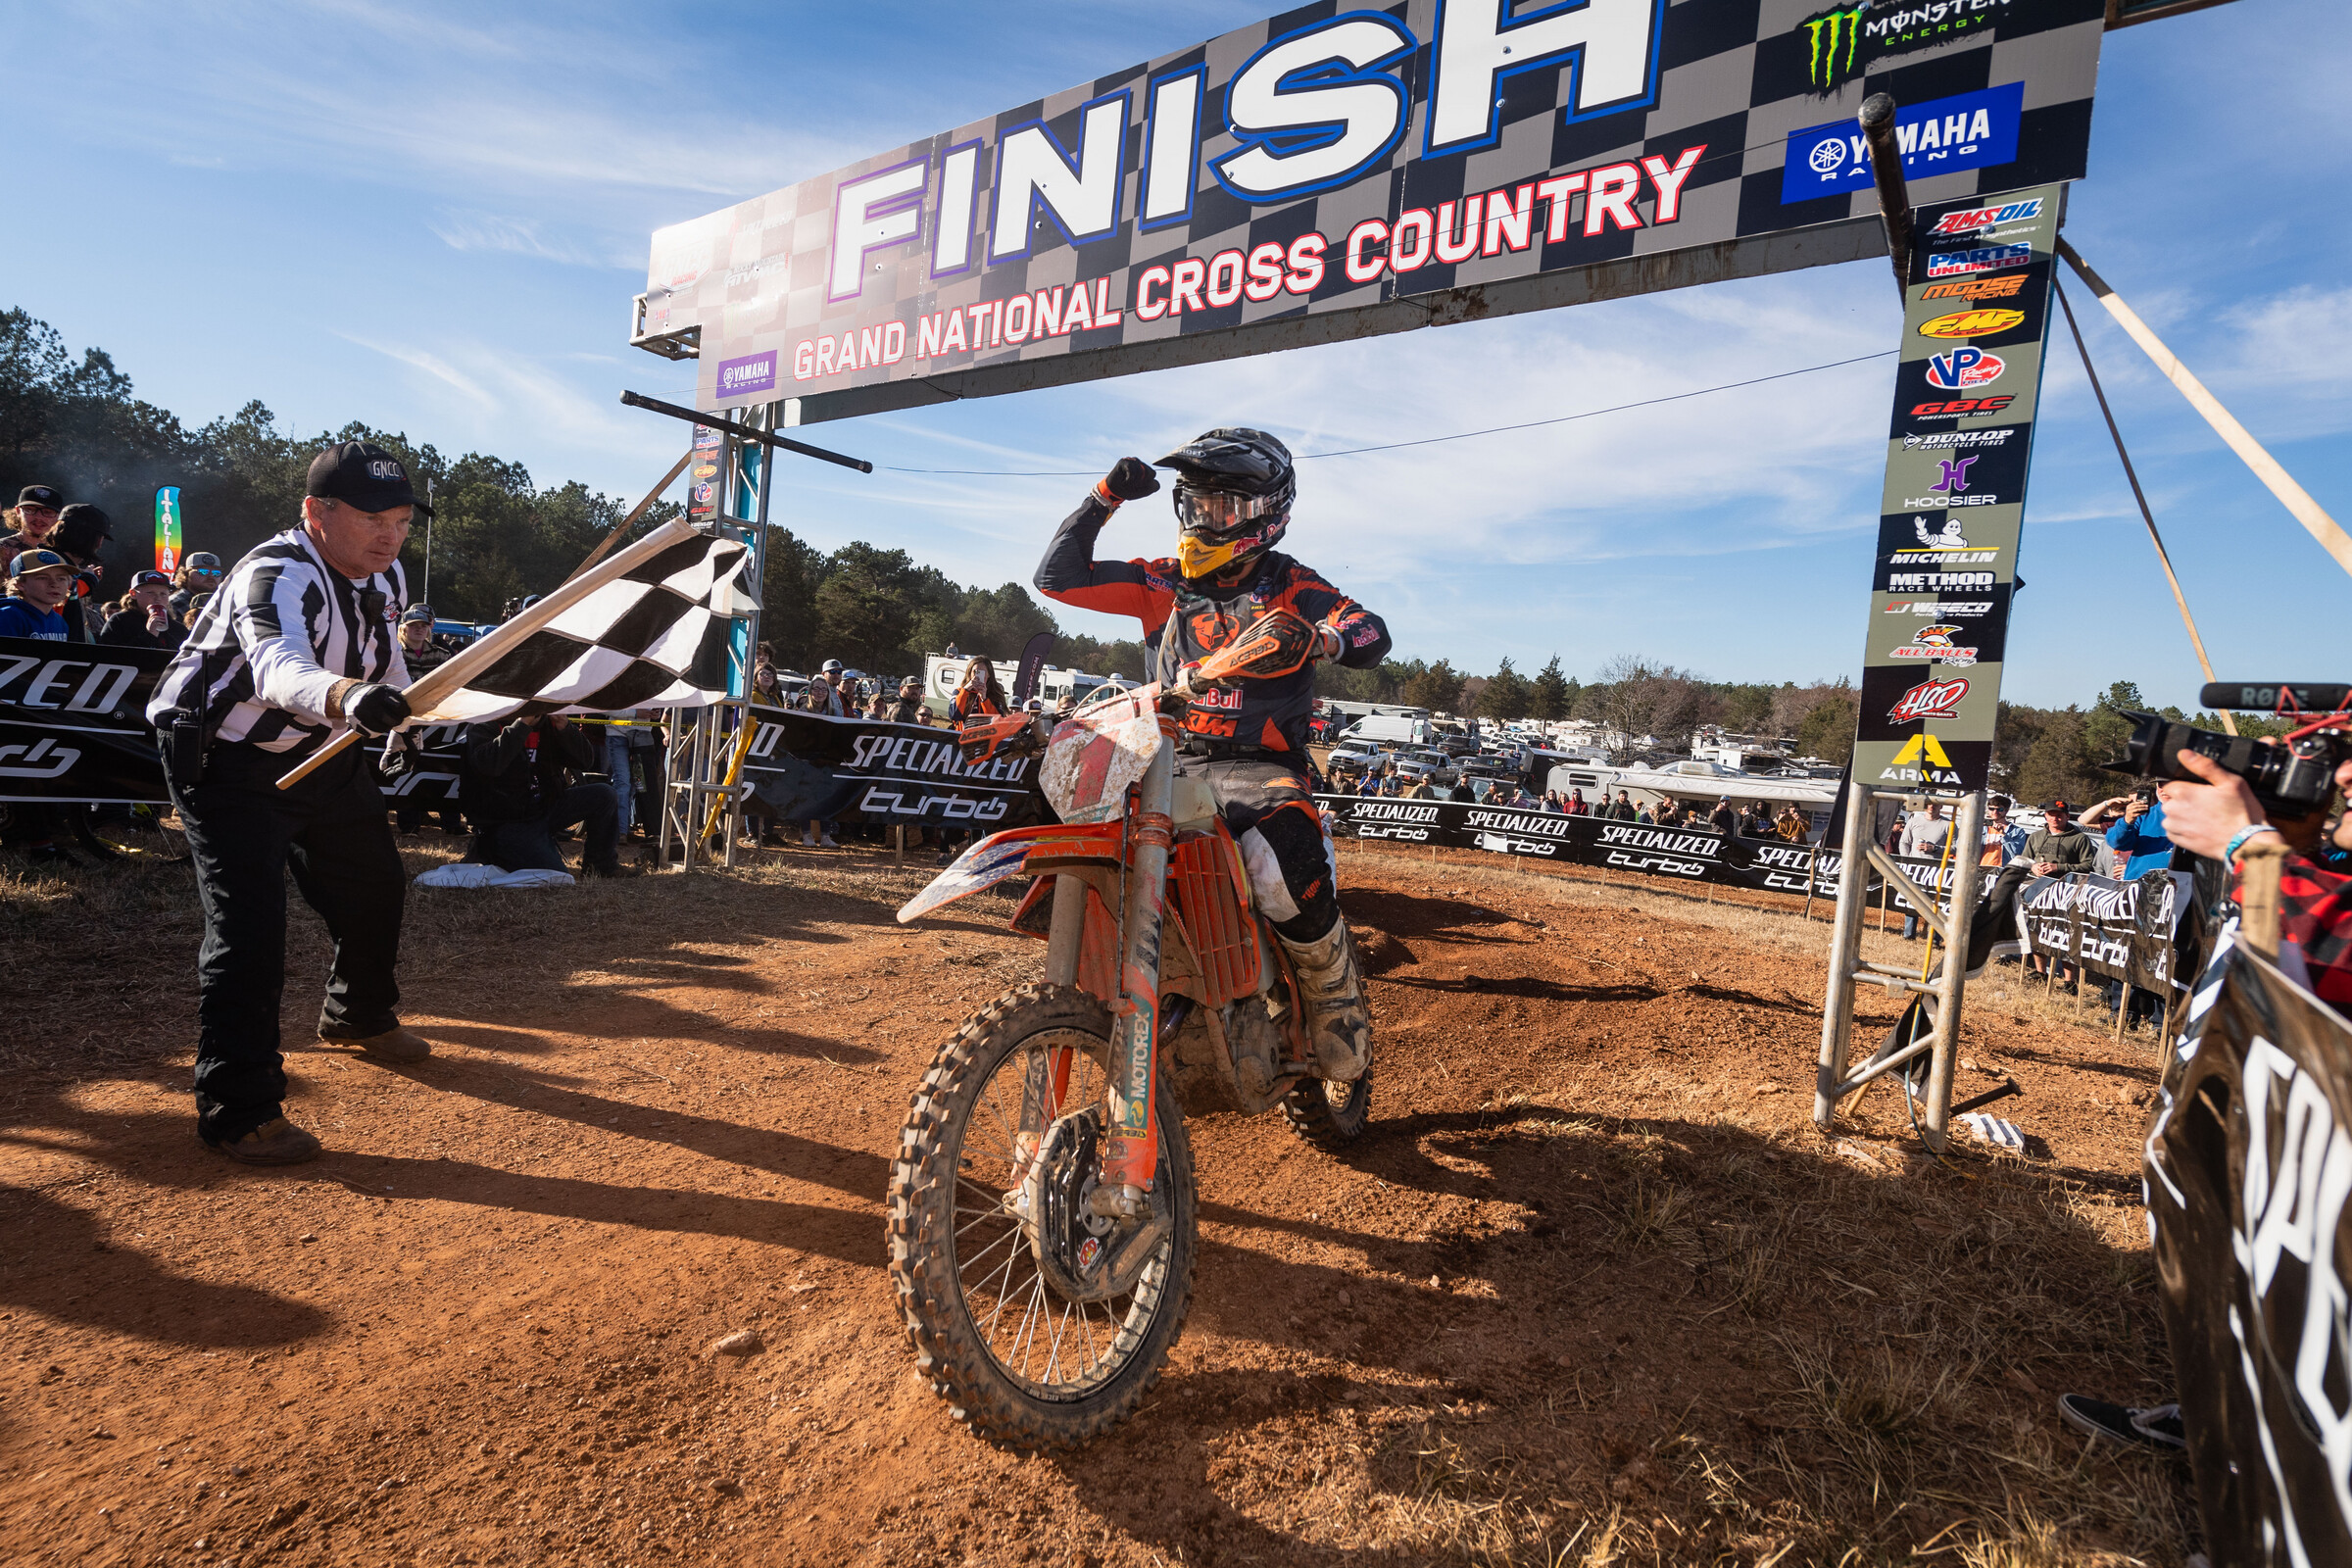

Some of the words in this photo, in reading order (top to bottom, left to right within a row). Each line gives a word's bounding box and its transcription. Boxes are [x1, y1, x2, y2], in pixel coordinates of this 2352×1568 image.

[1886, 15, 1985, 46] ENERGY
[1850, 109, 1990, 164] YMAHA
[829, 0, 1665, 304] FINISH
[1821, 144, 1979, 182] RAING
[1928, 198, 2043, 235] AMSOIL
[793, 319, 907, 382] GRAND
[916, 277, 1123, 361] NATIONAL
[1136, 232, 1328, 320] CROSS
[1345, 144, 1708, 283] COUNTRY
[1929, 241, 2032, 268] PARTS
[1929, 256, 2031, 277] UNLIMITED
[1921, 273, 2031, 301] MOOSE
[1959, 288, 2019, 302] RACING
[1918, 310, 2026, 336] FMF
[734, 361, 770, 381] YAMAHA
[1931, 347, 1984, 388] VP
[1911, 395, 2017, 416] GBC
[1917, 412, 1969, 421] POWERSPORTS
[697, 436, 719, 445] PARTS
[1919, 441, 1976, 451] MOTORCYCLE
[1922, 429, 2015, 445] DUNLOP
[372, 461, 400, 478] GNCC
[1904, 494, 1997, 508] HOOSIER
[1889, 552, 1997, 564] MICHELIN
[1889, 572, 1995, 586] METHOD
[1893, 647, 1922, 658] ALL
[1924, 647, 1977, 658] BALLS
[1206, 688, 1243, 710] Bull
[1178, 709, 1239, 738] KTM
[1879, 767, 1963, 784] ARMA
[859, 786, 1008, 820] turbo
[1350, 802, 1440, 823] SPECIALIZED
[1357, 823, 1429, 841] turbo
[1467, 810, 1570, 838] SPECIALIZED
[1473, 833, 1557, 856] trbo
[1597, 825, 1721, 858] SPECIALIZED
[1606, 851, 1706, 876] turbo
[1763, 872, 1839, 896] turb
[1130, 1011, 1151, 1099] MOTOREX
